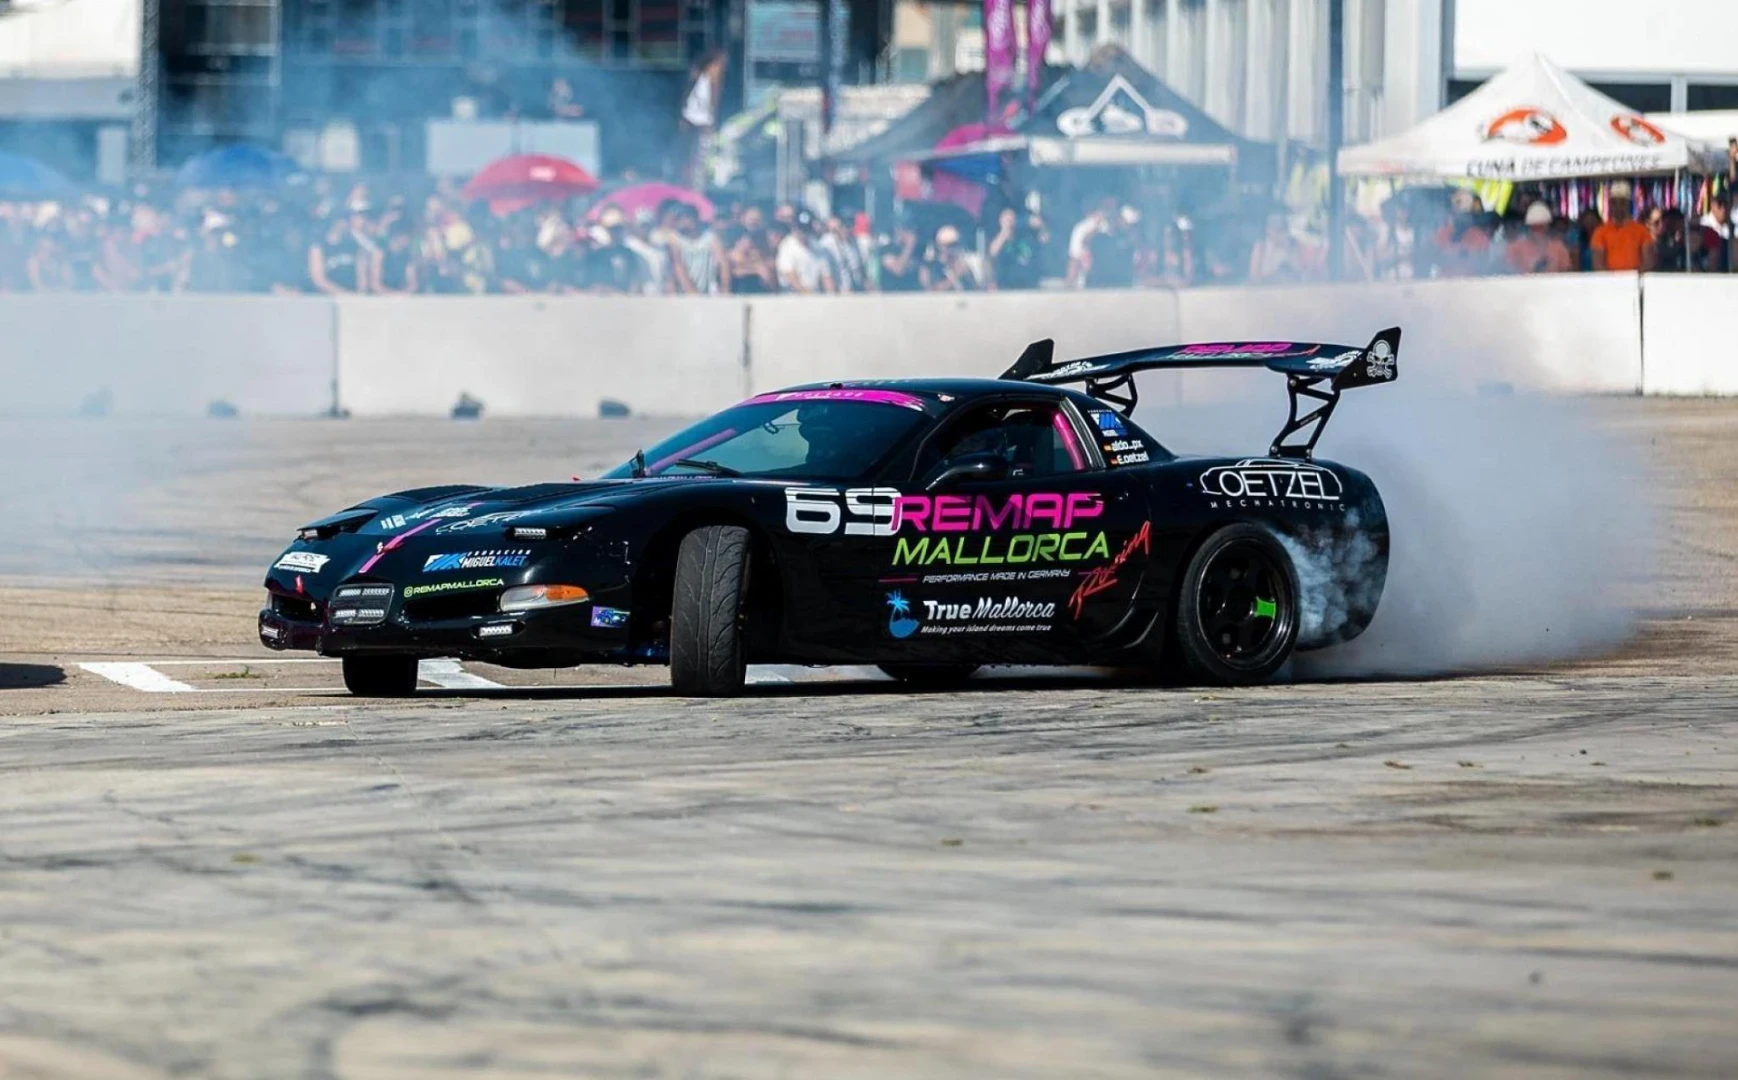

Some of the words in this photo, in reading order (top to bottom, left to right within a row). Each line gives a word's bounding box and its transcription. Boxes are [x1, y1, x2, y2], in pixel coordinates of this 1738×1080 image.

[1219, 470, 1340, 500] OETZEL
[785, 487, 902, 536] 69
[891, 493, 1105, 531] REMAP
[1210, 500, 1346, 512] MECHATRONIC
[892, 531, 1109, 566] MALLORCA
[922, 573, 988, 583] PERFORMANCE
[990, 571, 1016, 581] MADE
[1017, 571, 1026, 580] IN
[1027, 568, 1071, 579] GERMANY
[923, 600, 972, 620] True
[972, 596, 1056, 619] Mallorca
[920, 625, 947, 635] Making
[948, 626, 966, 635] your
[989, 624, 1015, 632] dreams
